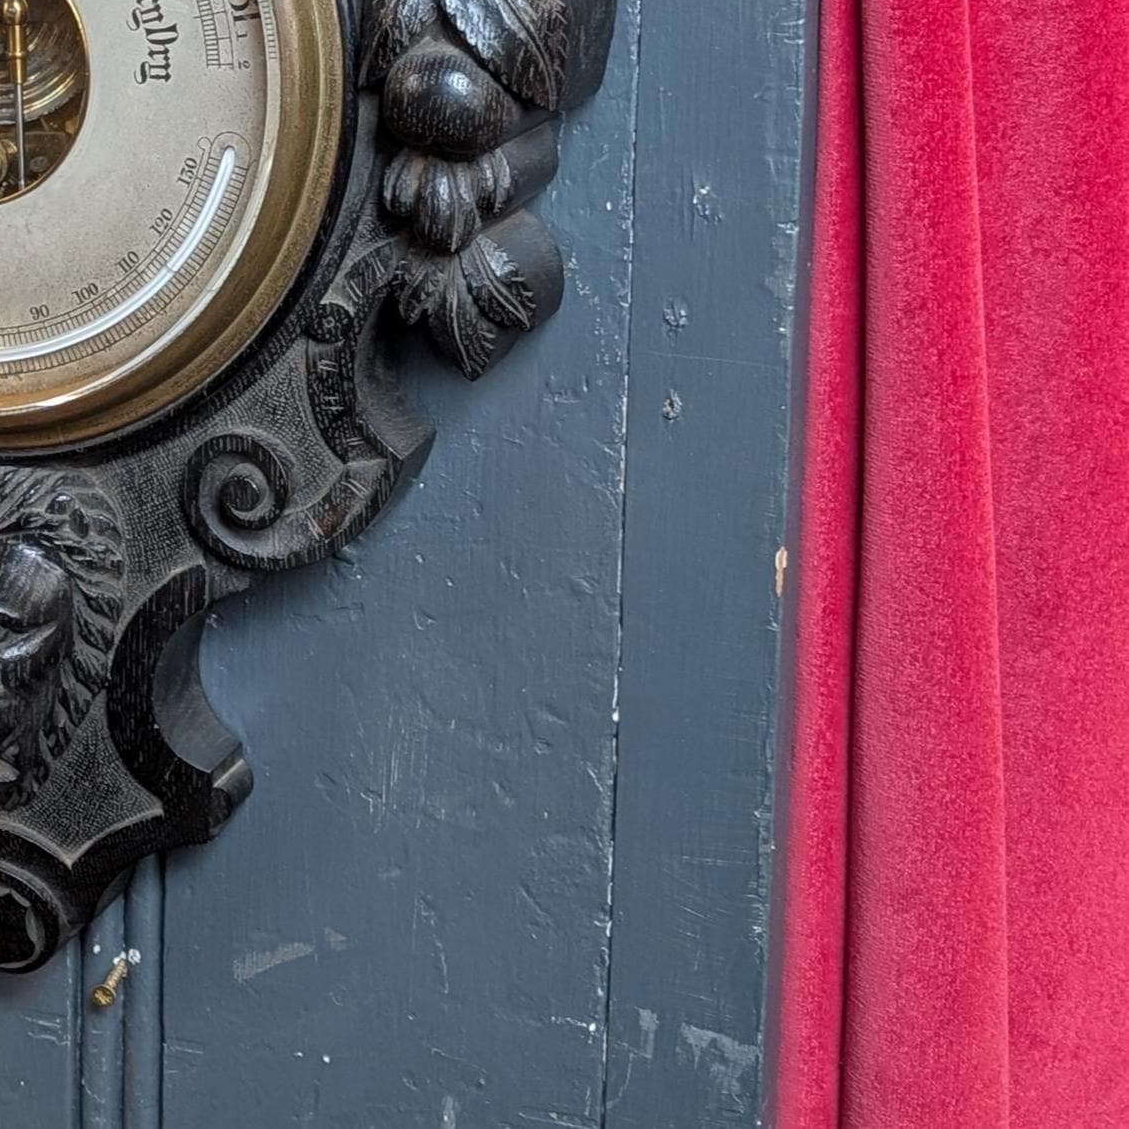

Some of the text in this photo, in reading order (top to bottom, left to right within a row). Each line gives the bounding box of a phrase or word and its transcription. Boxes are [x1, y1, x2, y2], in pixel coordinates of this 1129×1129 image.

[236, 30, 248, 41] 1
[29, 304, 50, 321] 90
[72, 283, 99, 306] 100
[118, 251, 140, 275] 110
[149, 208, 174, 237] 120
[176, 157, 198, 189] 130
